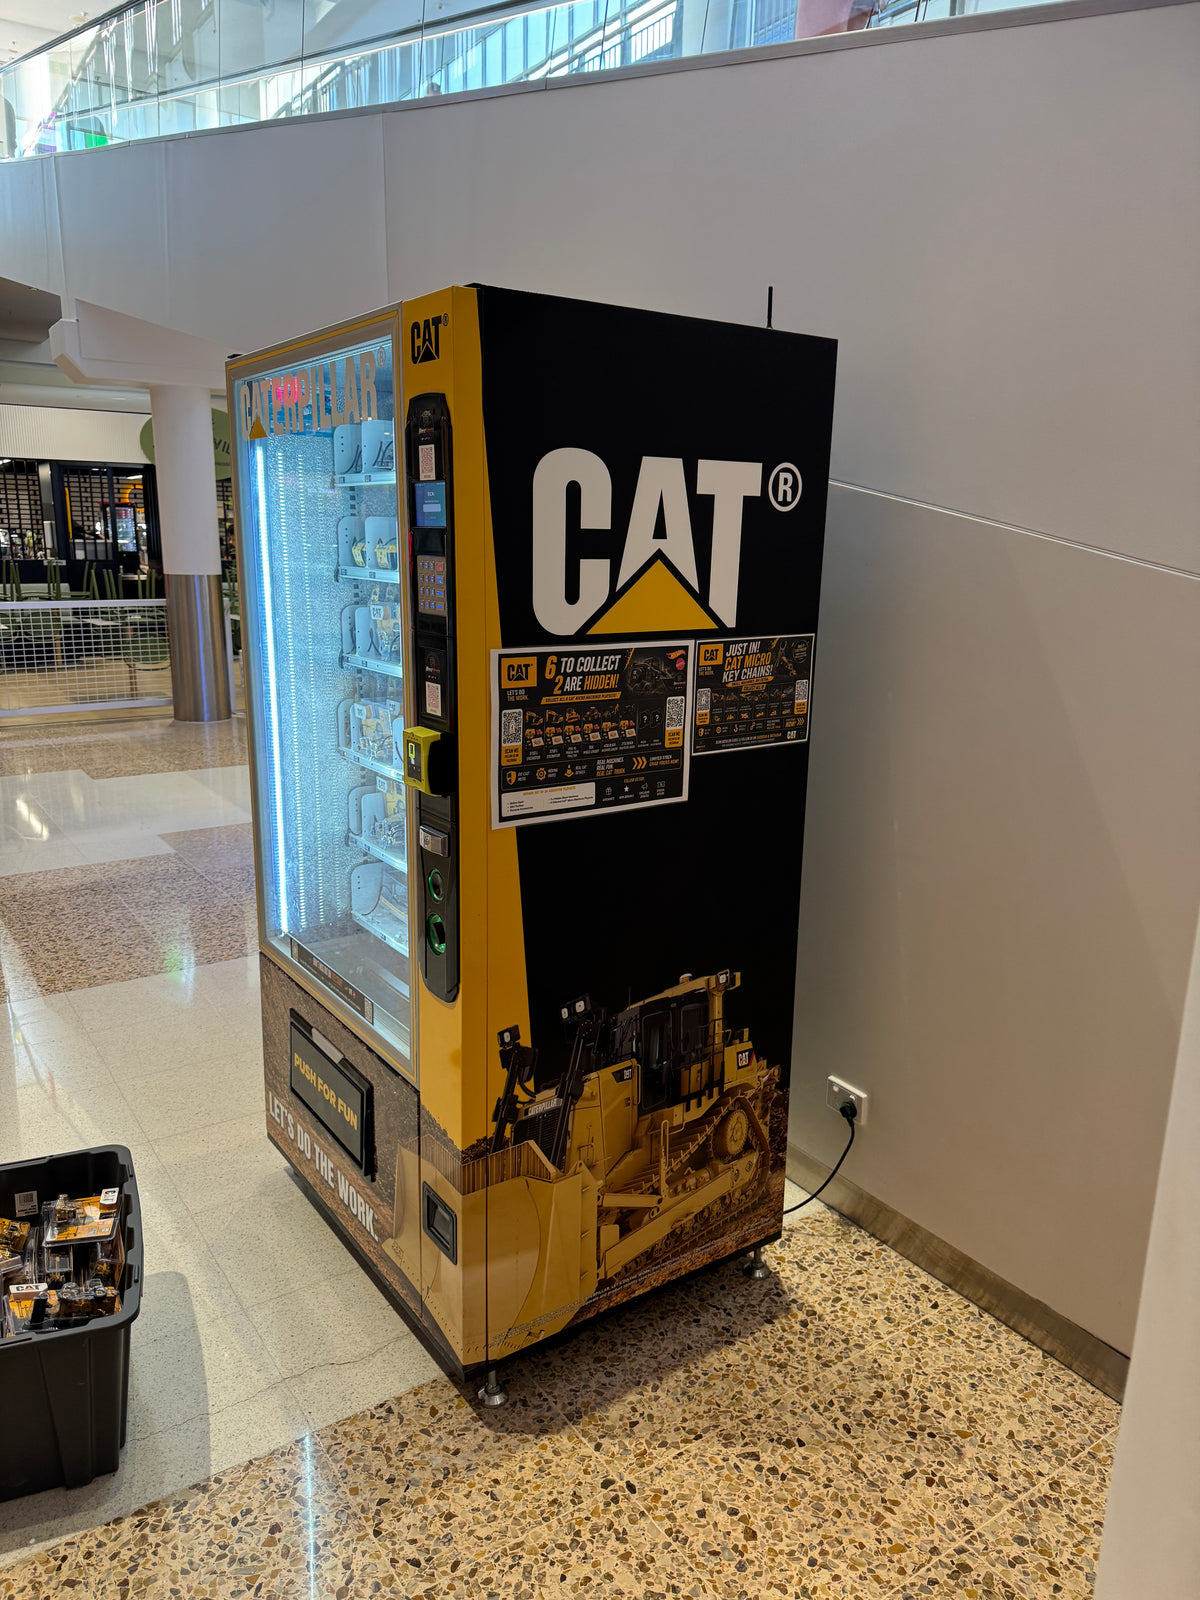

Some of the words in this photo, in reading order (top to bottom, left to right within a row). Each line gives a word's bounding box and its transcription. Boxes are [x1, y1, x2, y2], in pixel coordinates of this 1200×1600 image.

[703, 648, 719, 662] CAT
[726, 642, 748, 657] JUST
[748, 641, 761, 654] IN!
[545, 655, 557, 680] 6
[561, 657, 576, 673] TO
[576, 655, 622, 673] COLLECT
[724, 656, 742, 671] CAT
[743, 652, 772, 668] MICRO
[507, 663, 530, 682] CAT
[722, 669, 739, 683] KEY
[741, 664, 774, 680] CHAINS!
[553, 676, 564, 695] 2
[563, 675, 583, 692] ARE
[583, 673, 620, 691] HIDDEN!
[787, 730, 797, 740] CAT
[738, 1051, 749, 1067] CAT
[294, 1052, 317, 1088] PUSH
[317, 1076, 336, 1108] FOR
[337, 1099, 358, 1131] FUN
[268, 1091, 295, 1140] LET'S
[297, 1123, 312, 1160] DO
[315, 1143, 335, 1189] THE
[15, 1284, 40, 1293] CAT
